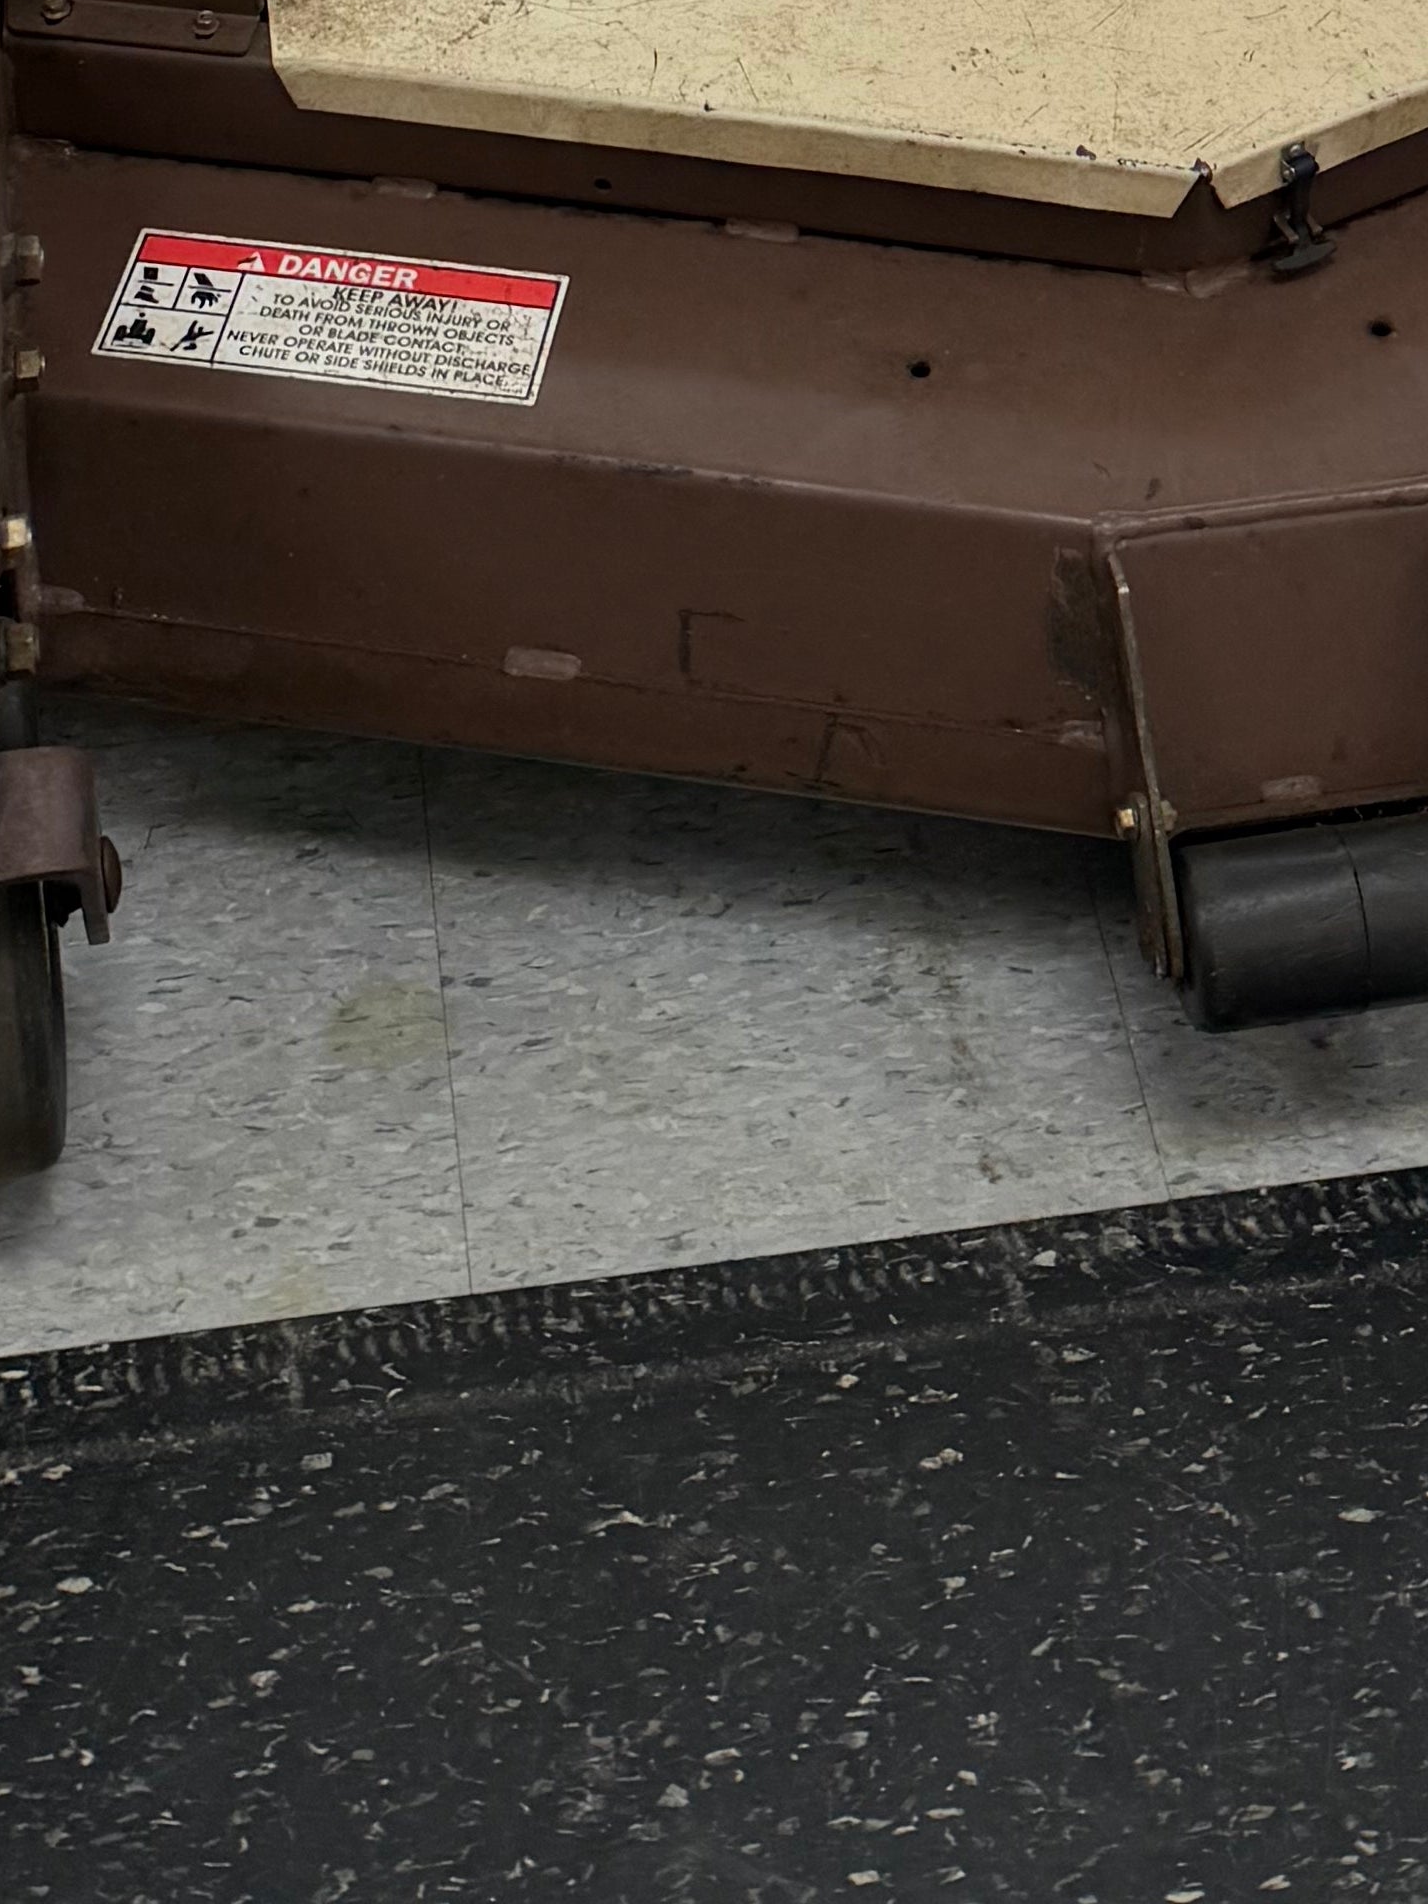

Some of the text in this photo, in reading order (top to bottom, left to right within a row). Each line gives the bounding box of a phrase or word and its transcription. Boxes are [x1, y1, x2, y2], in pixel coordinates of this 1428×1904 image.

[275, 254, 419, 289] DANGER
[271, 293, 512, 331] TO AVOID SERIOUS INJURY OR
[331, 286, 459, 313] KEEP AWAY!
[258, 305, 311, 322] DEATH
[313, 312, 365, 328] FROM
[368, 318, 438, 337] THROWN
[297, 323, 324, 337] OR
[326, 326, 378, 343] BLADE
[226, 329, 531, 376] NEVER OPERATE WITHOUT DISCHARGE
[237, 344, 291, 361] CHUTE
[293, 351, 320, 365] OR
[323, 354, 361, 370] SIDE
[362, 358, 428, 377] SHIELDS
[430, 366, 450, 380] IN
